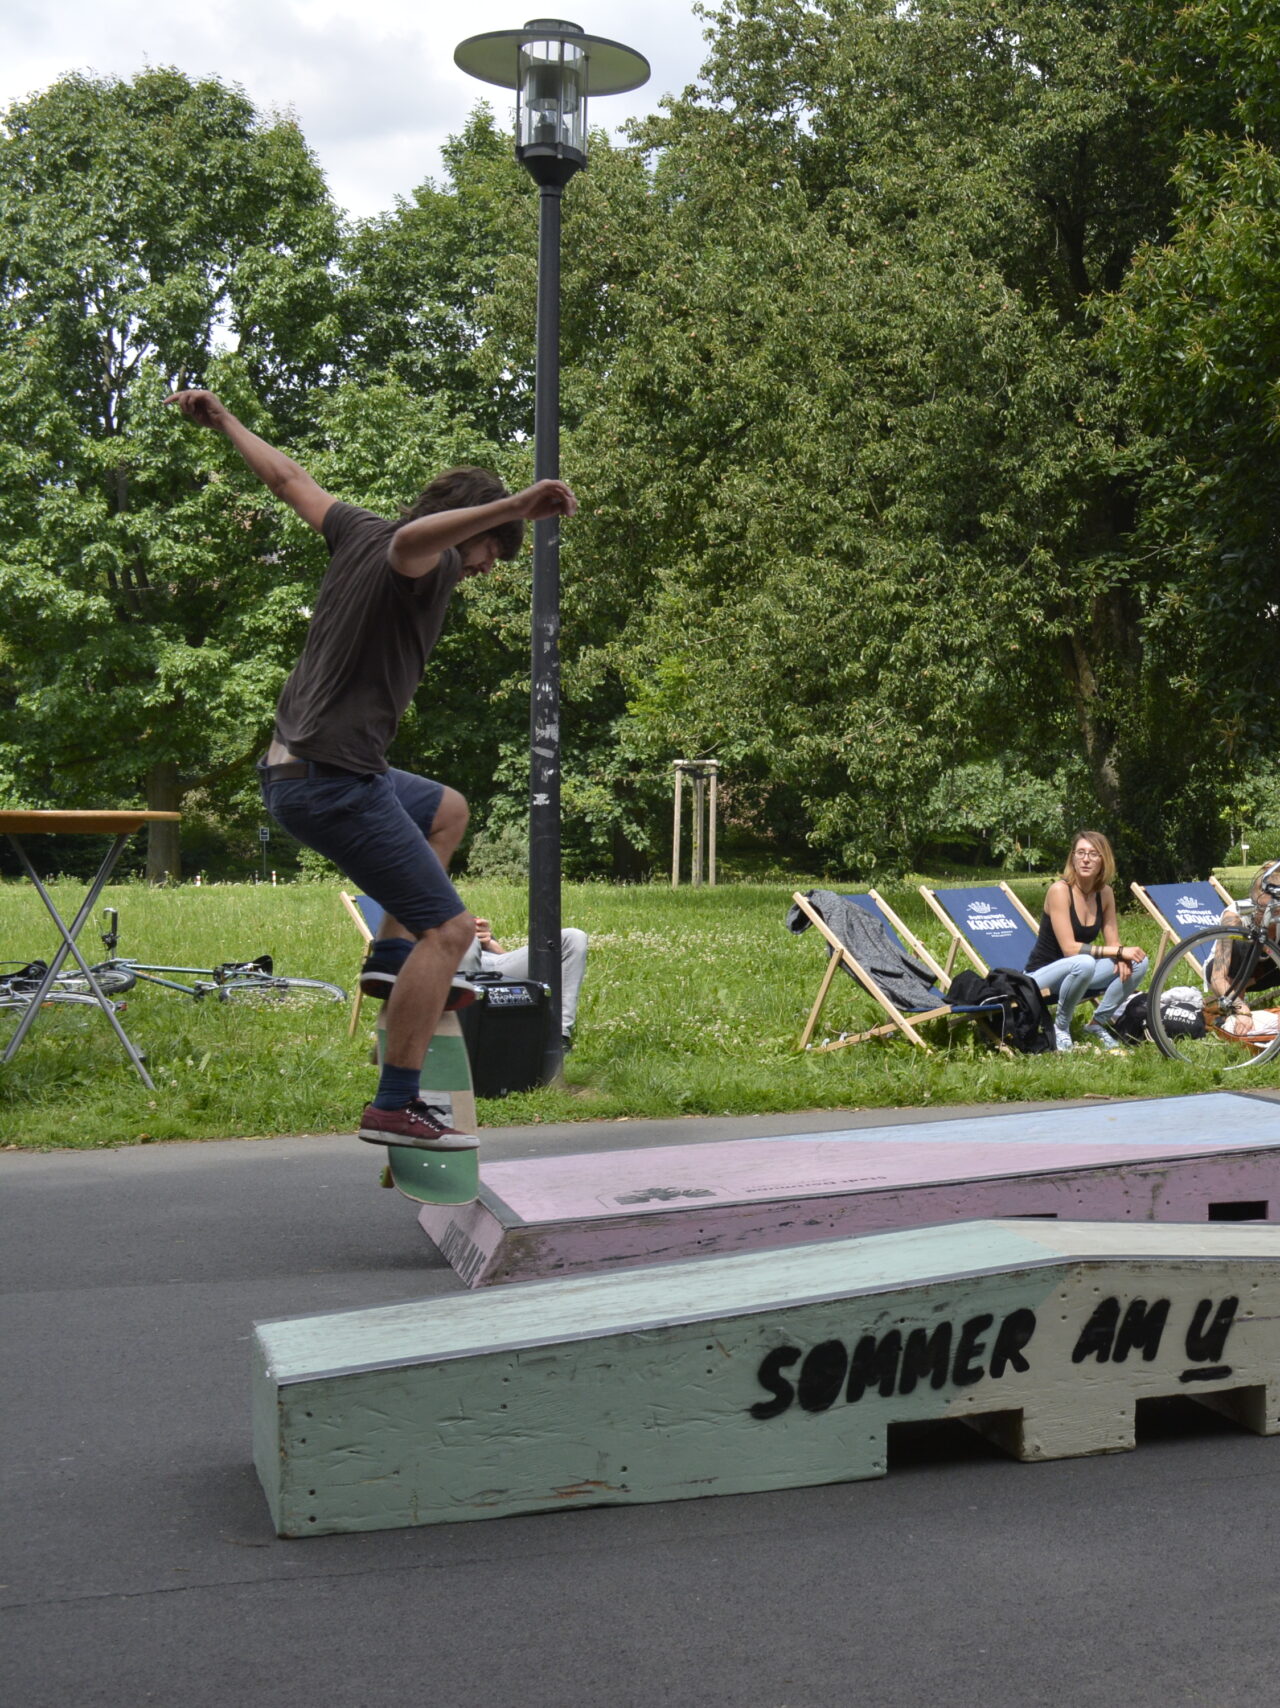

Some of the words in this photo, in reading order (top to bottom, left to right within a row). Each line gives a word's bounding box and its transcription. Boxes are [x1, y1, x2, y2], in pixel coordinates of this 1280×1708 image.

[966, 919, 1018, 930] KRONEN
[1175, 914, 1220, 926] KRONEN
[1163, 1015, 1196, 1025] COMPANY
[748, 1308, 1036, 1420] SOMMER
[1072, 1296, 1171, 1364] AM
